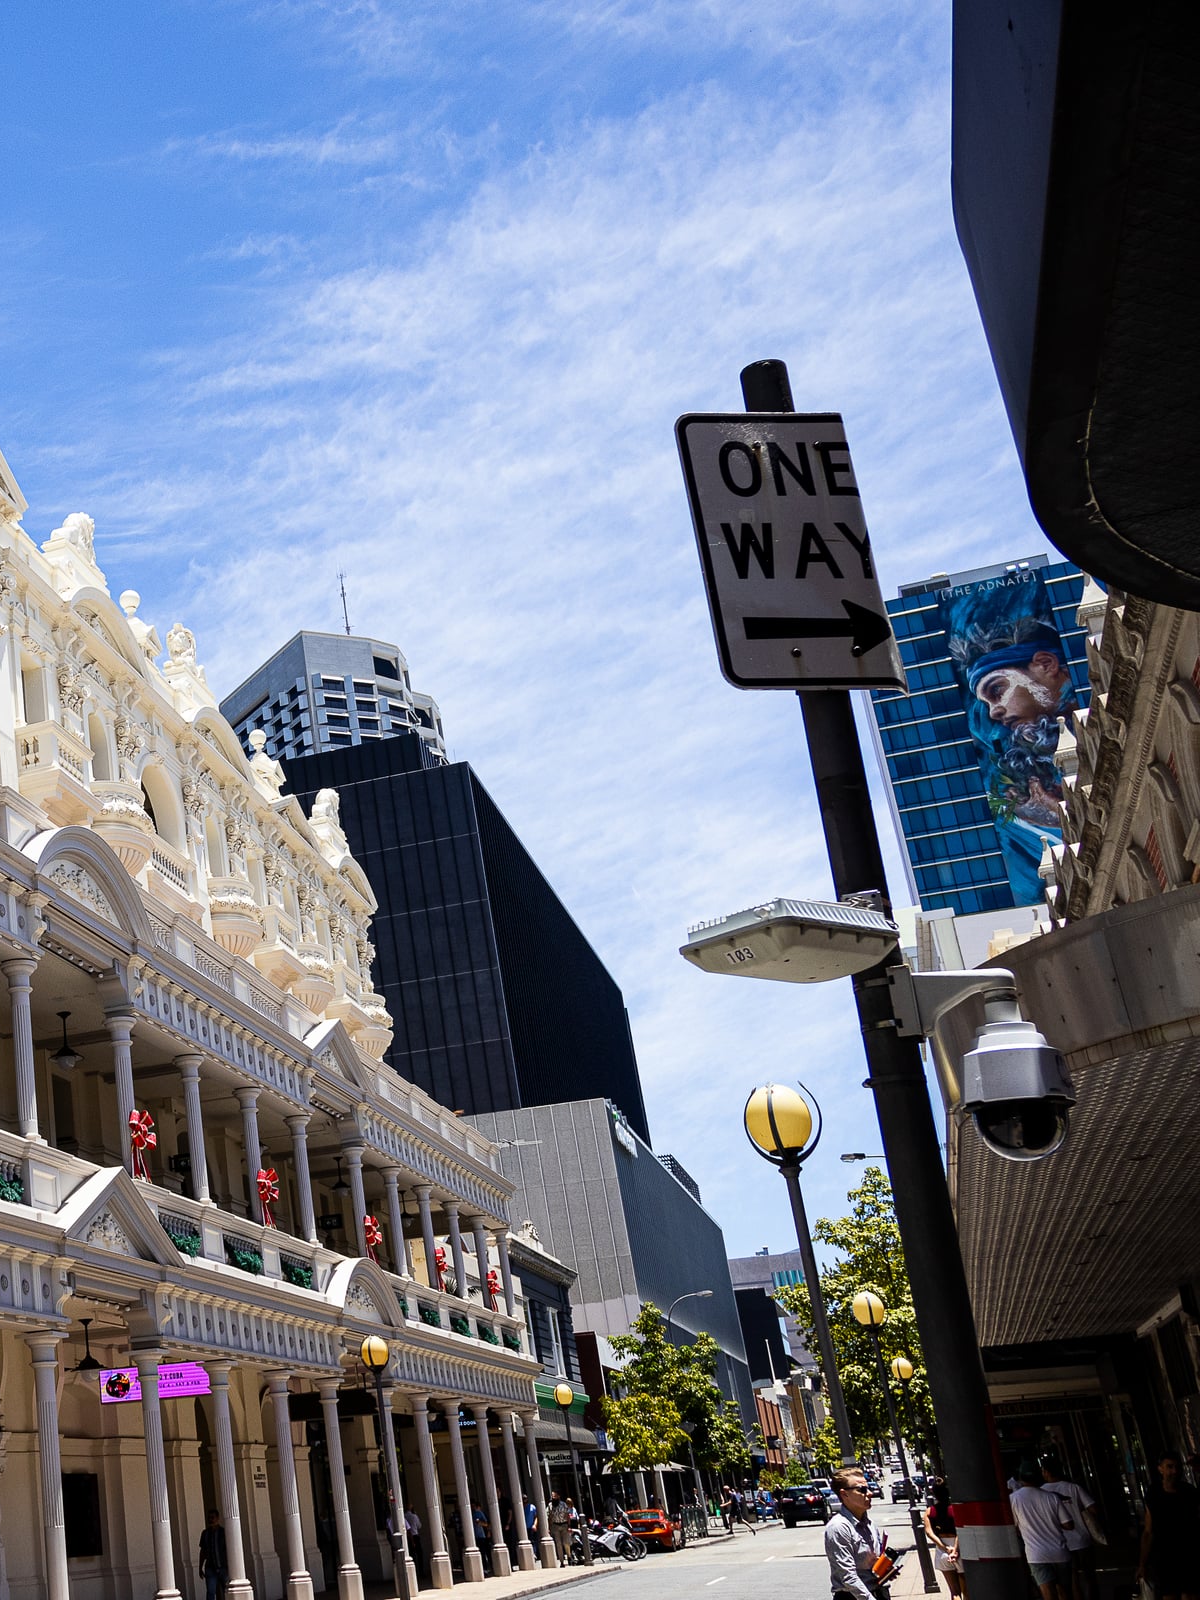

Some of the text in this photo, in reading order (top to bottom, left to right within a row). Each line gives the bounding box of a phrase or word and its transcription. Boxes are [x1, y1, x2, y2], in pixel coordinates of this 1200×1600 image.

[718, 441, 861, 497] ONE
[720, 522, 874, 579] WAY
[726, 948, 754, 964] 103
